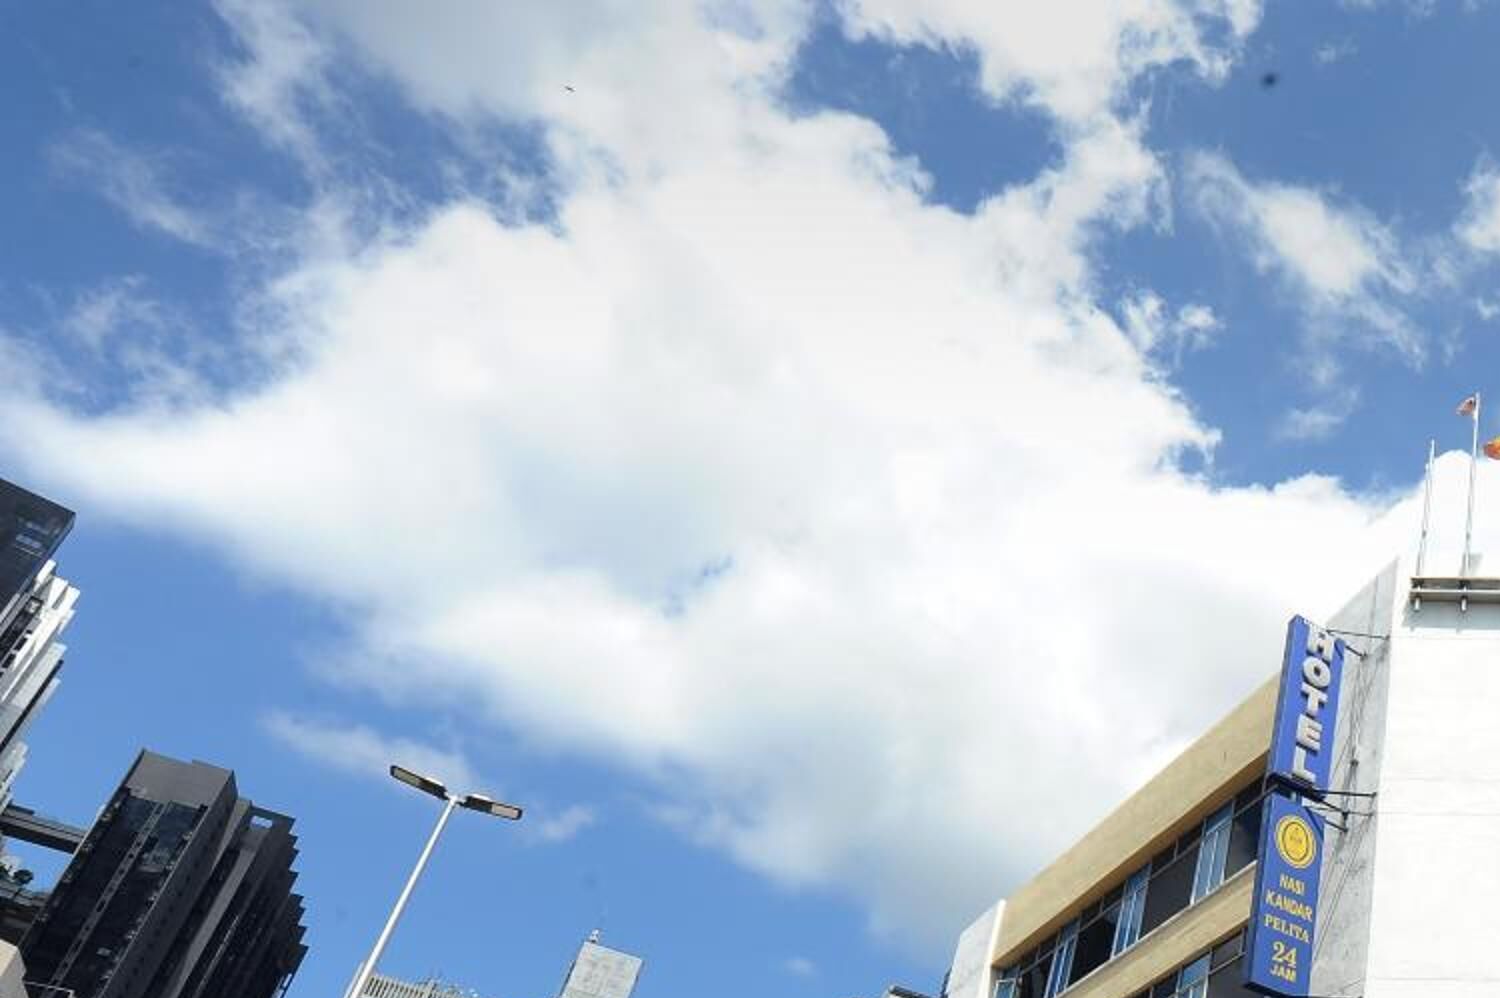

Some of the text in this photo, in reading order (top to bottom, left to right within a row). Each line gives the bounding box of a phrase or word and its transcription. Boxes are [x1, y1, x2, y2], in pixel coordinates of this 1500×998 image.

[1293, 623, 1335, 784] HOTEL
[1279, 873, 1305, 897] NASI
[1265, 889, 1313, 922] KANDAR
[1263, 913, 1311, 944] PELITA
[1271, 940, 1297, 968] 24
[1269, 965, 1297, 983] JAM
